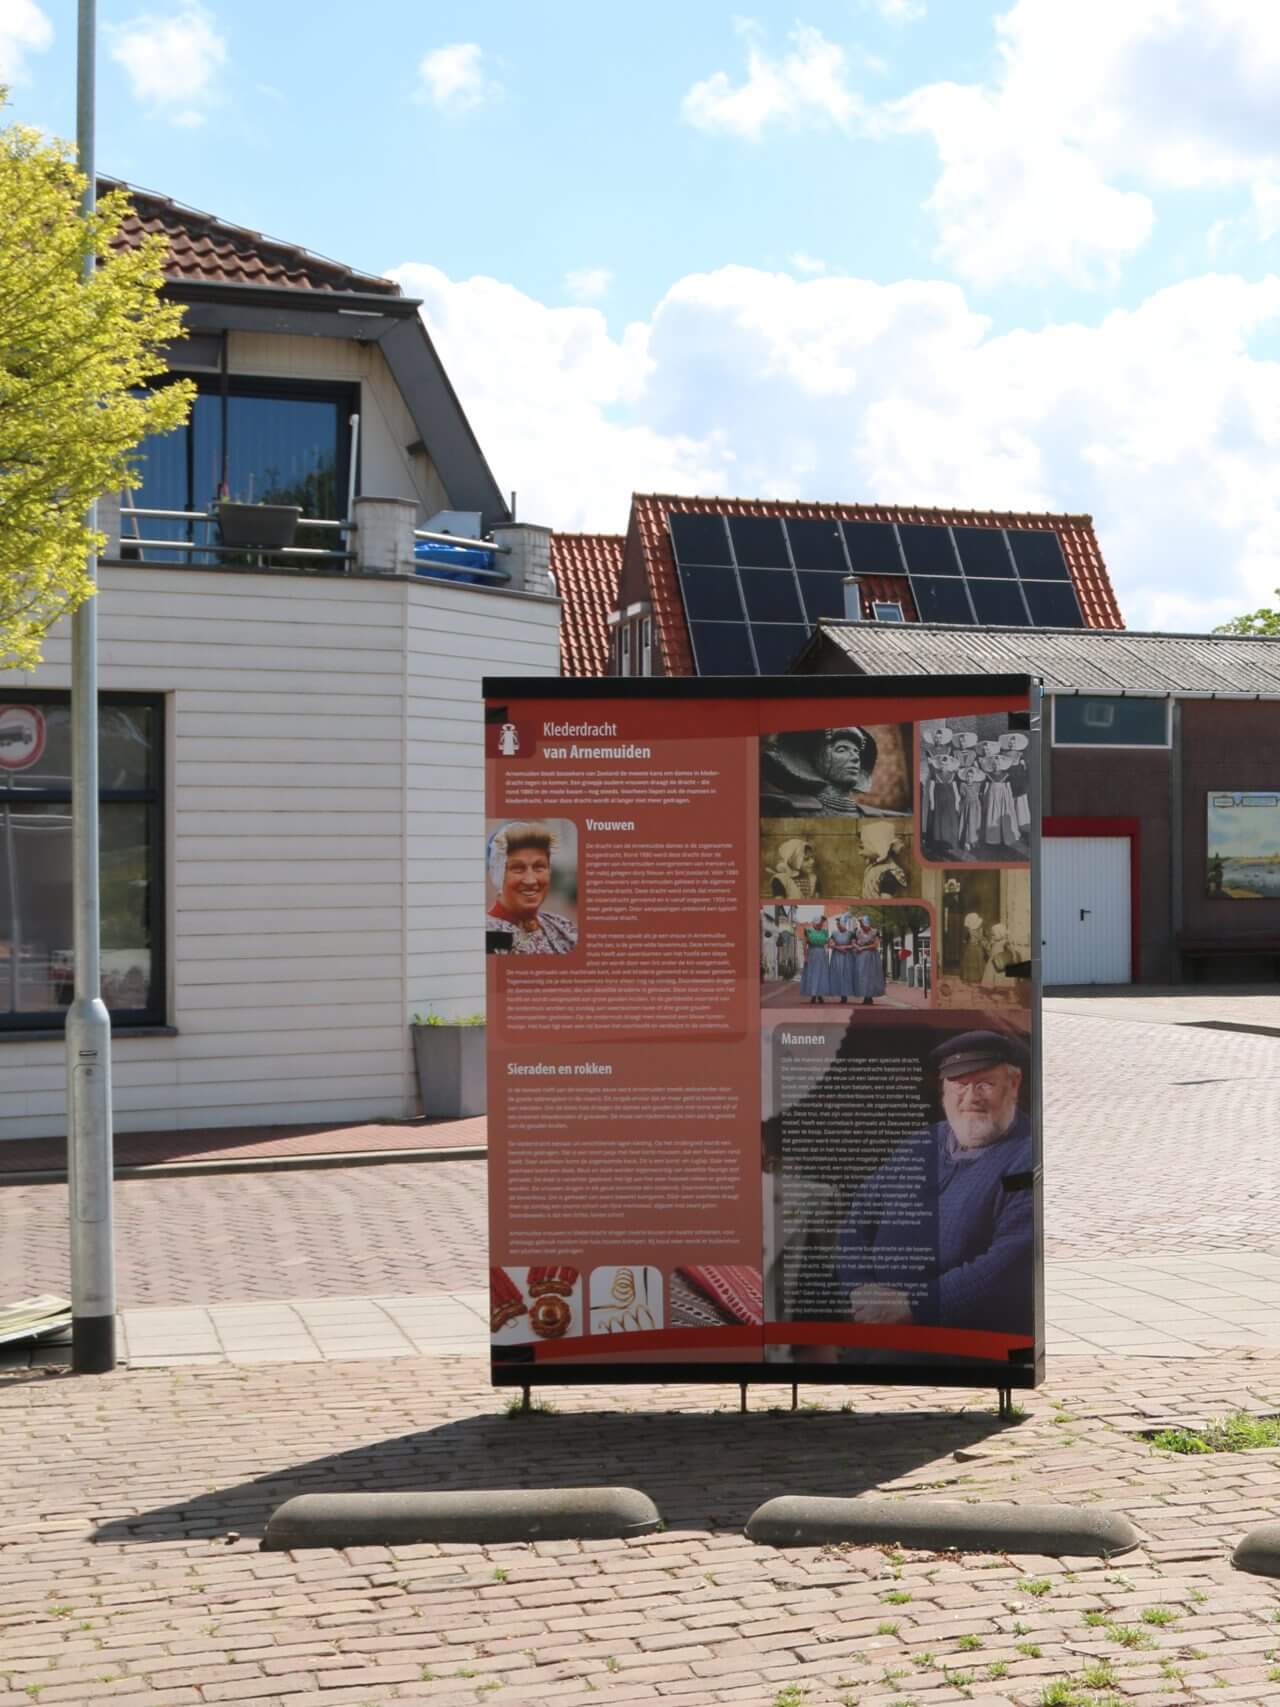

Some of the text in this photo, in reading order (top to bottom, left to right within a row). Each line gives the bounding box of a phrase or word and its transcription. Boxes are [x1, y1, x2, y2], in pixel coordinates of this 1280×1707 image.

[543, 722, 617, 737] Klederdracht
[543, 744, 651, 760] van Arnemuiden
[586, 819, 635, 832] Vrouwen
[781, 1032, 825, 1046] Mannen
[507, 1062, 612, 1075] Sieraden en rokken
